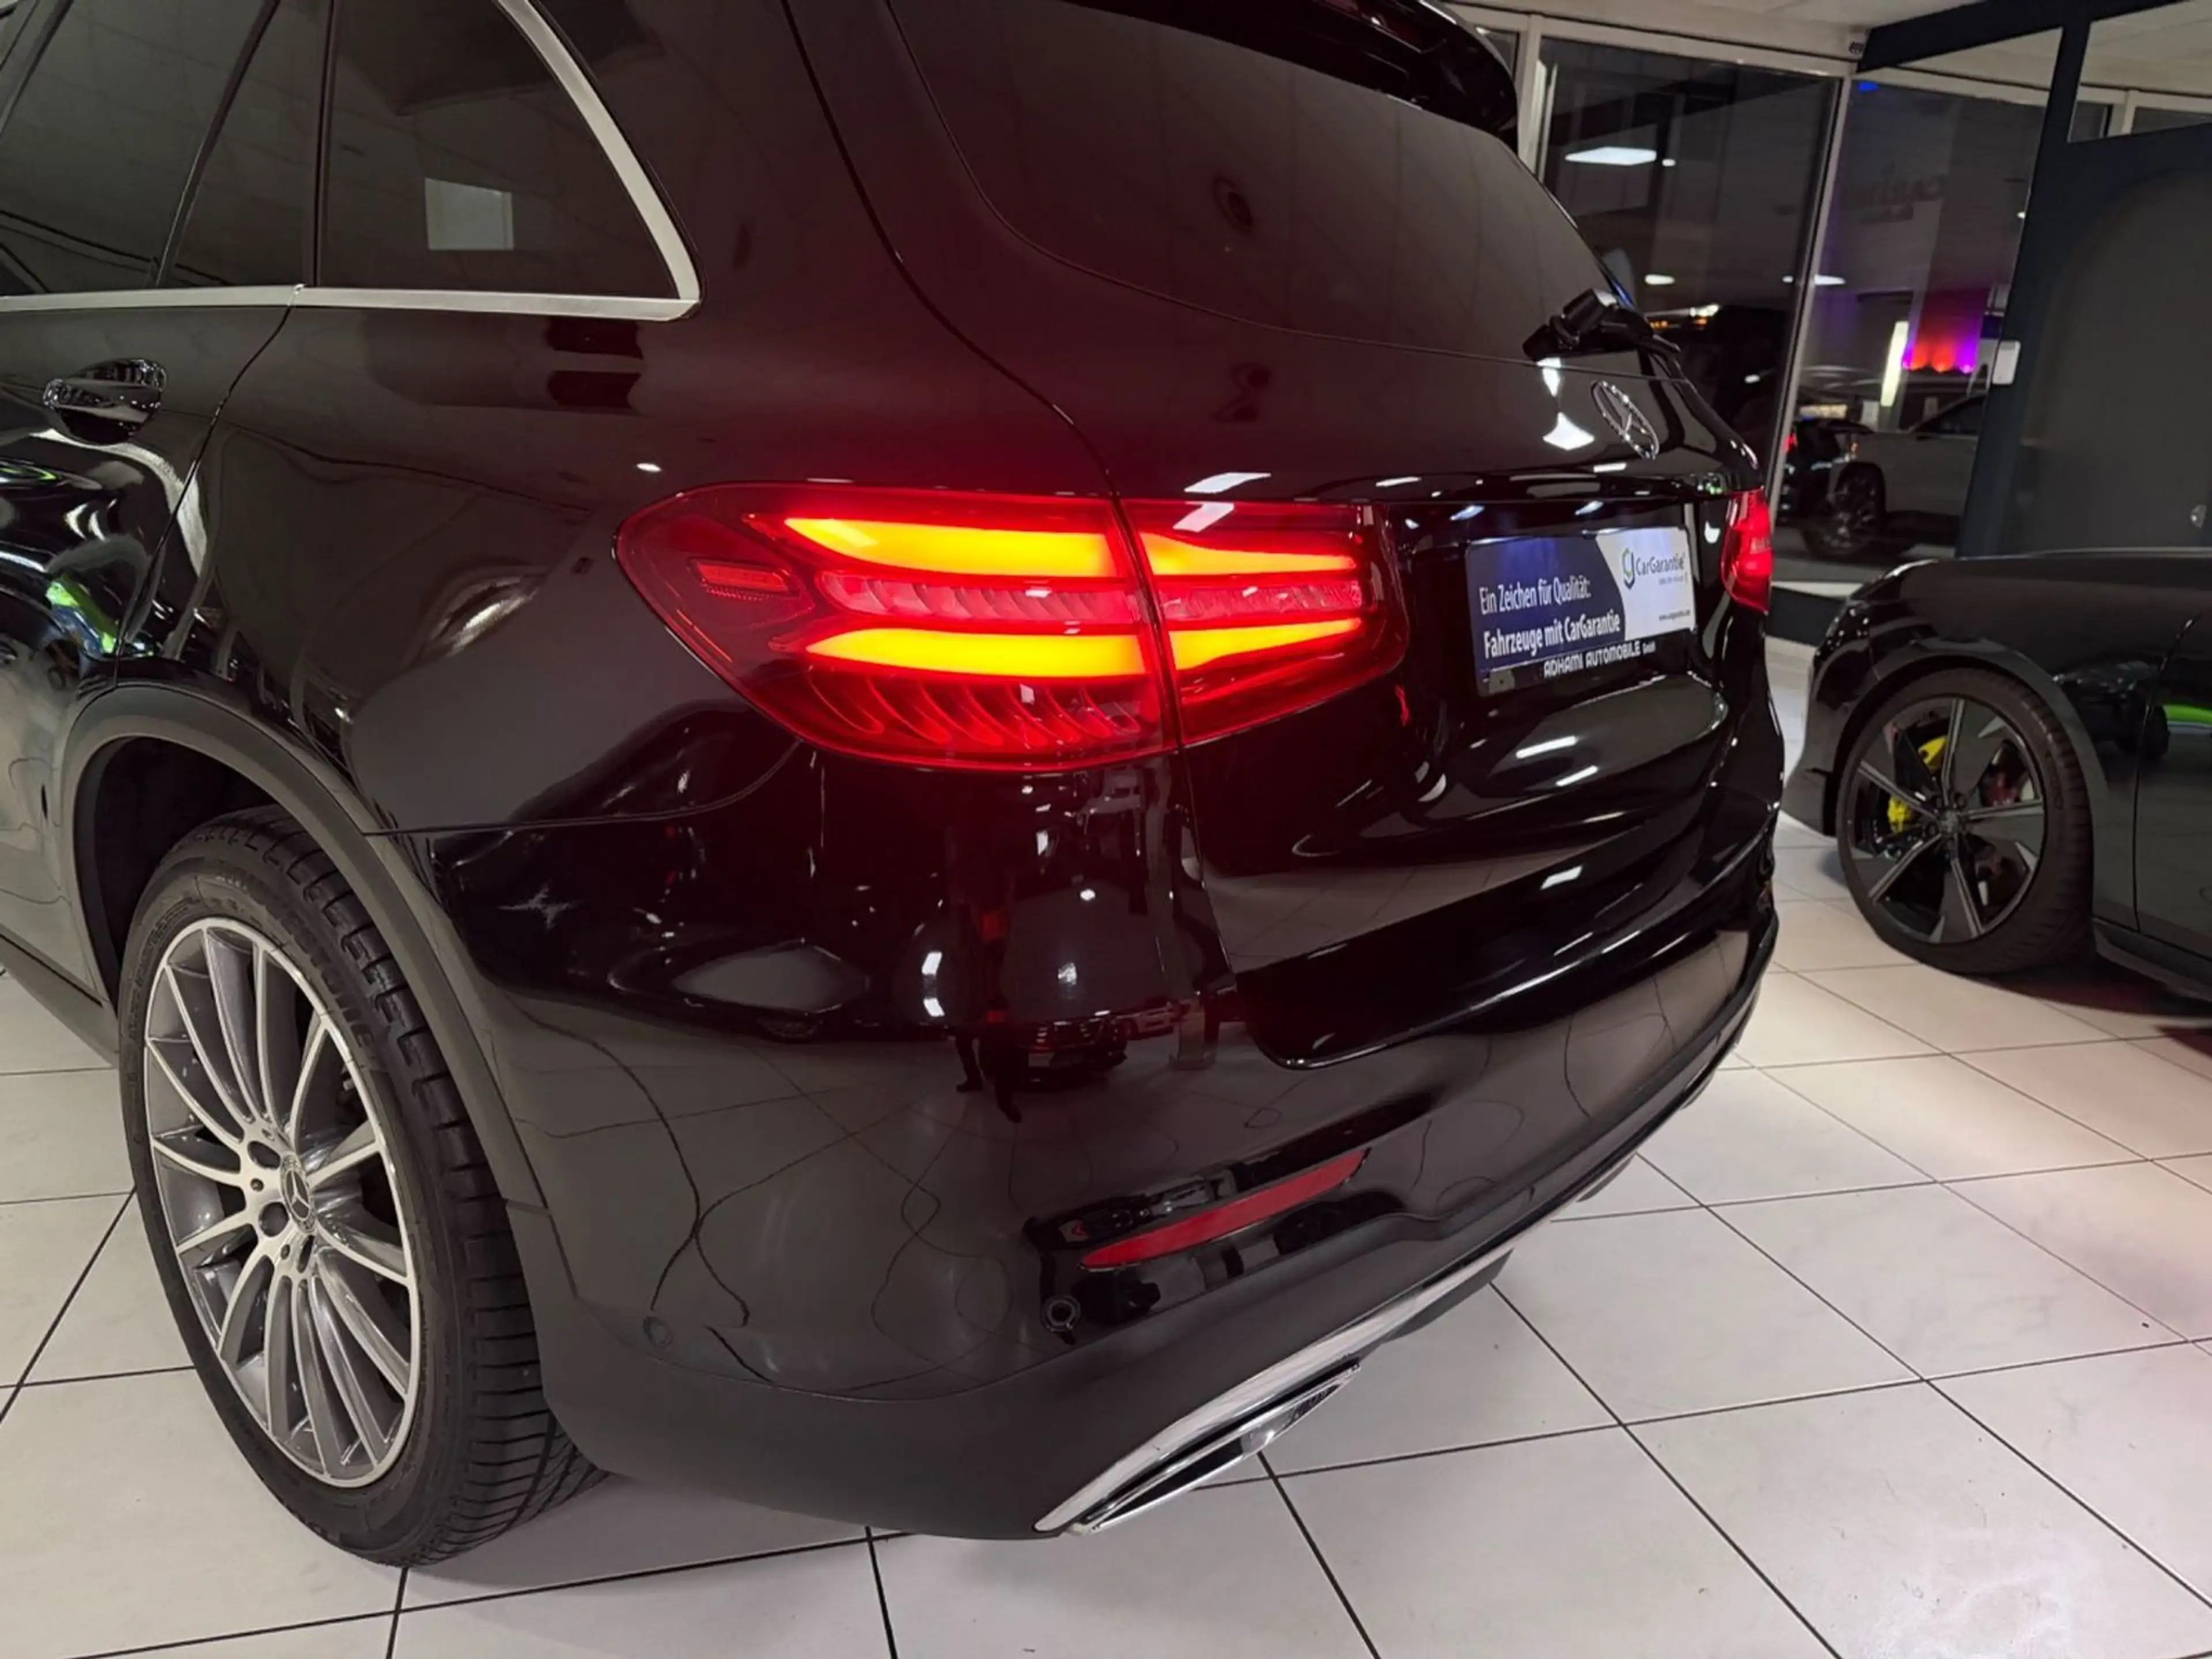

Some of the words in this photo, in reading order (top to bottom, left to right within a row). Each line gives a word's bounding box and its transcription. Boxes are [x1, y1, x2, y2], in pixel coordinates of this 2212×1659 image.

[1479, 586, 1497, 615] Ein
[1498, 581, 1537, 613] Zeichen
[1538, 578, 1552, 605] für
[1553, 575, 1592, 605] Qualität:
[1483, 628, 1543, 659] Fahrzeuge
[1544, 618, 1564, 646] mit
[1564, 609, 1620, 642] CarGarantie
[1544, 653, 1584, 679] ADHAMI
[1585, 641, 1641, 668] AUTOMOBILE
